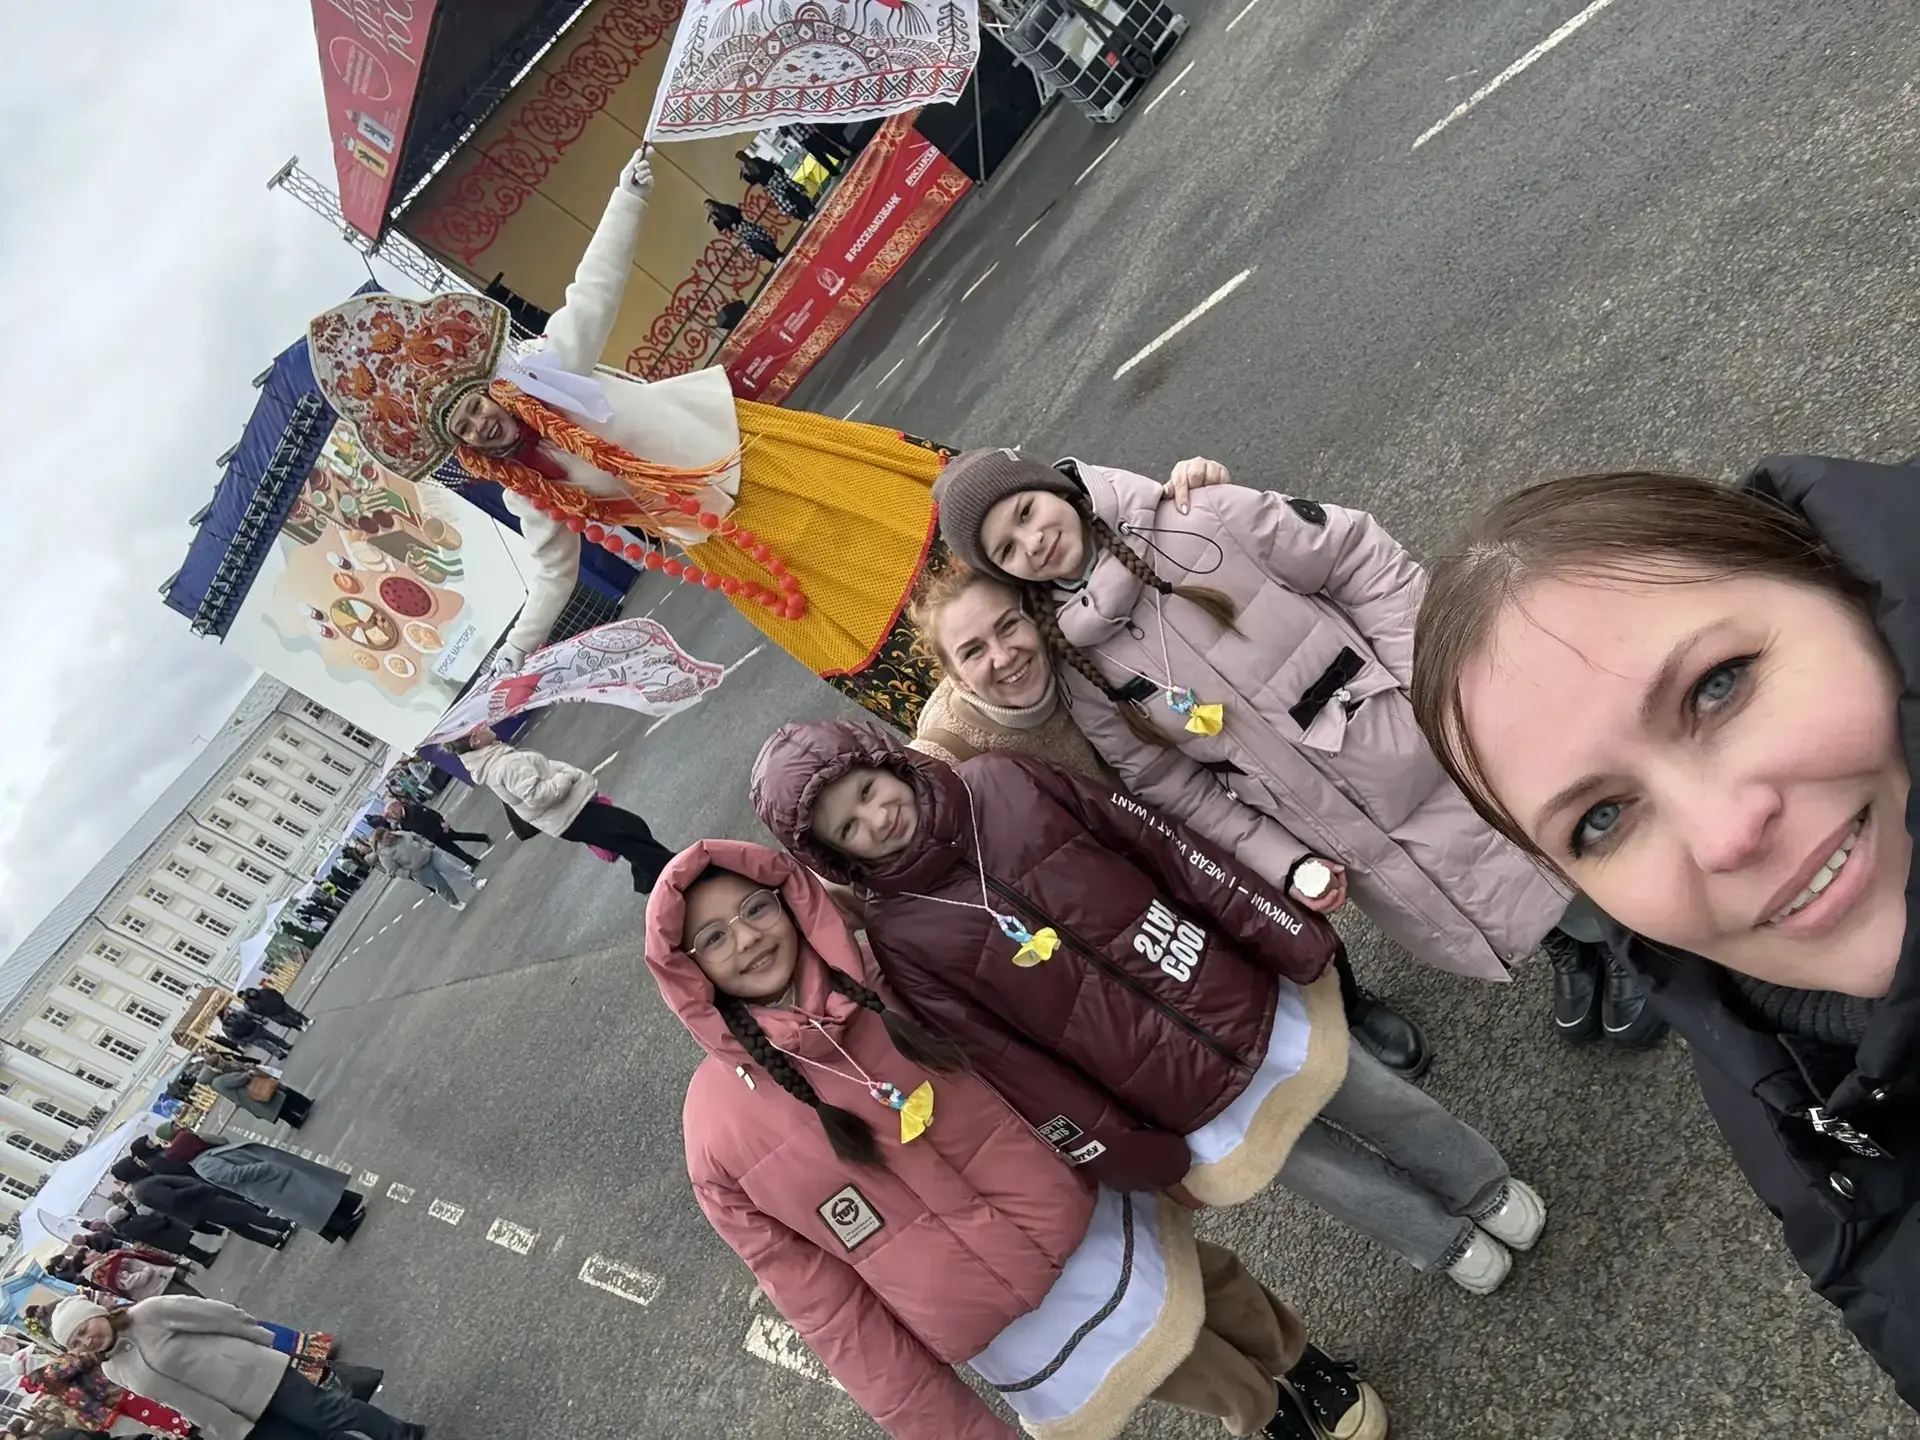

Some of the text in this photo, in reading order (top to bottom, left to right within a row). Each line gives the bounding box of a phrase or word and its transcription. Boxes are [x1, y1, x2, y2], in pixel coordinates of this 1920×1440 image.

[848, 192, 902, 258] РОССЕЛЬХОЗБАНК
[437, 624, 476, 675] ГОРОД МАСТЕРОВ
[1110, 792, 1148, 821] WANT
[1189, 849, 1226, 884] WEAR
